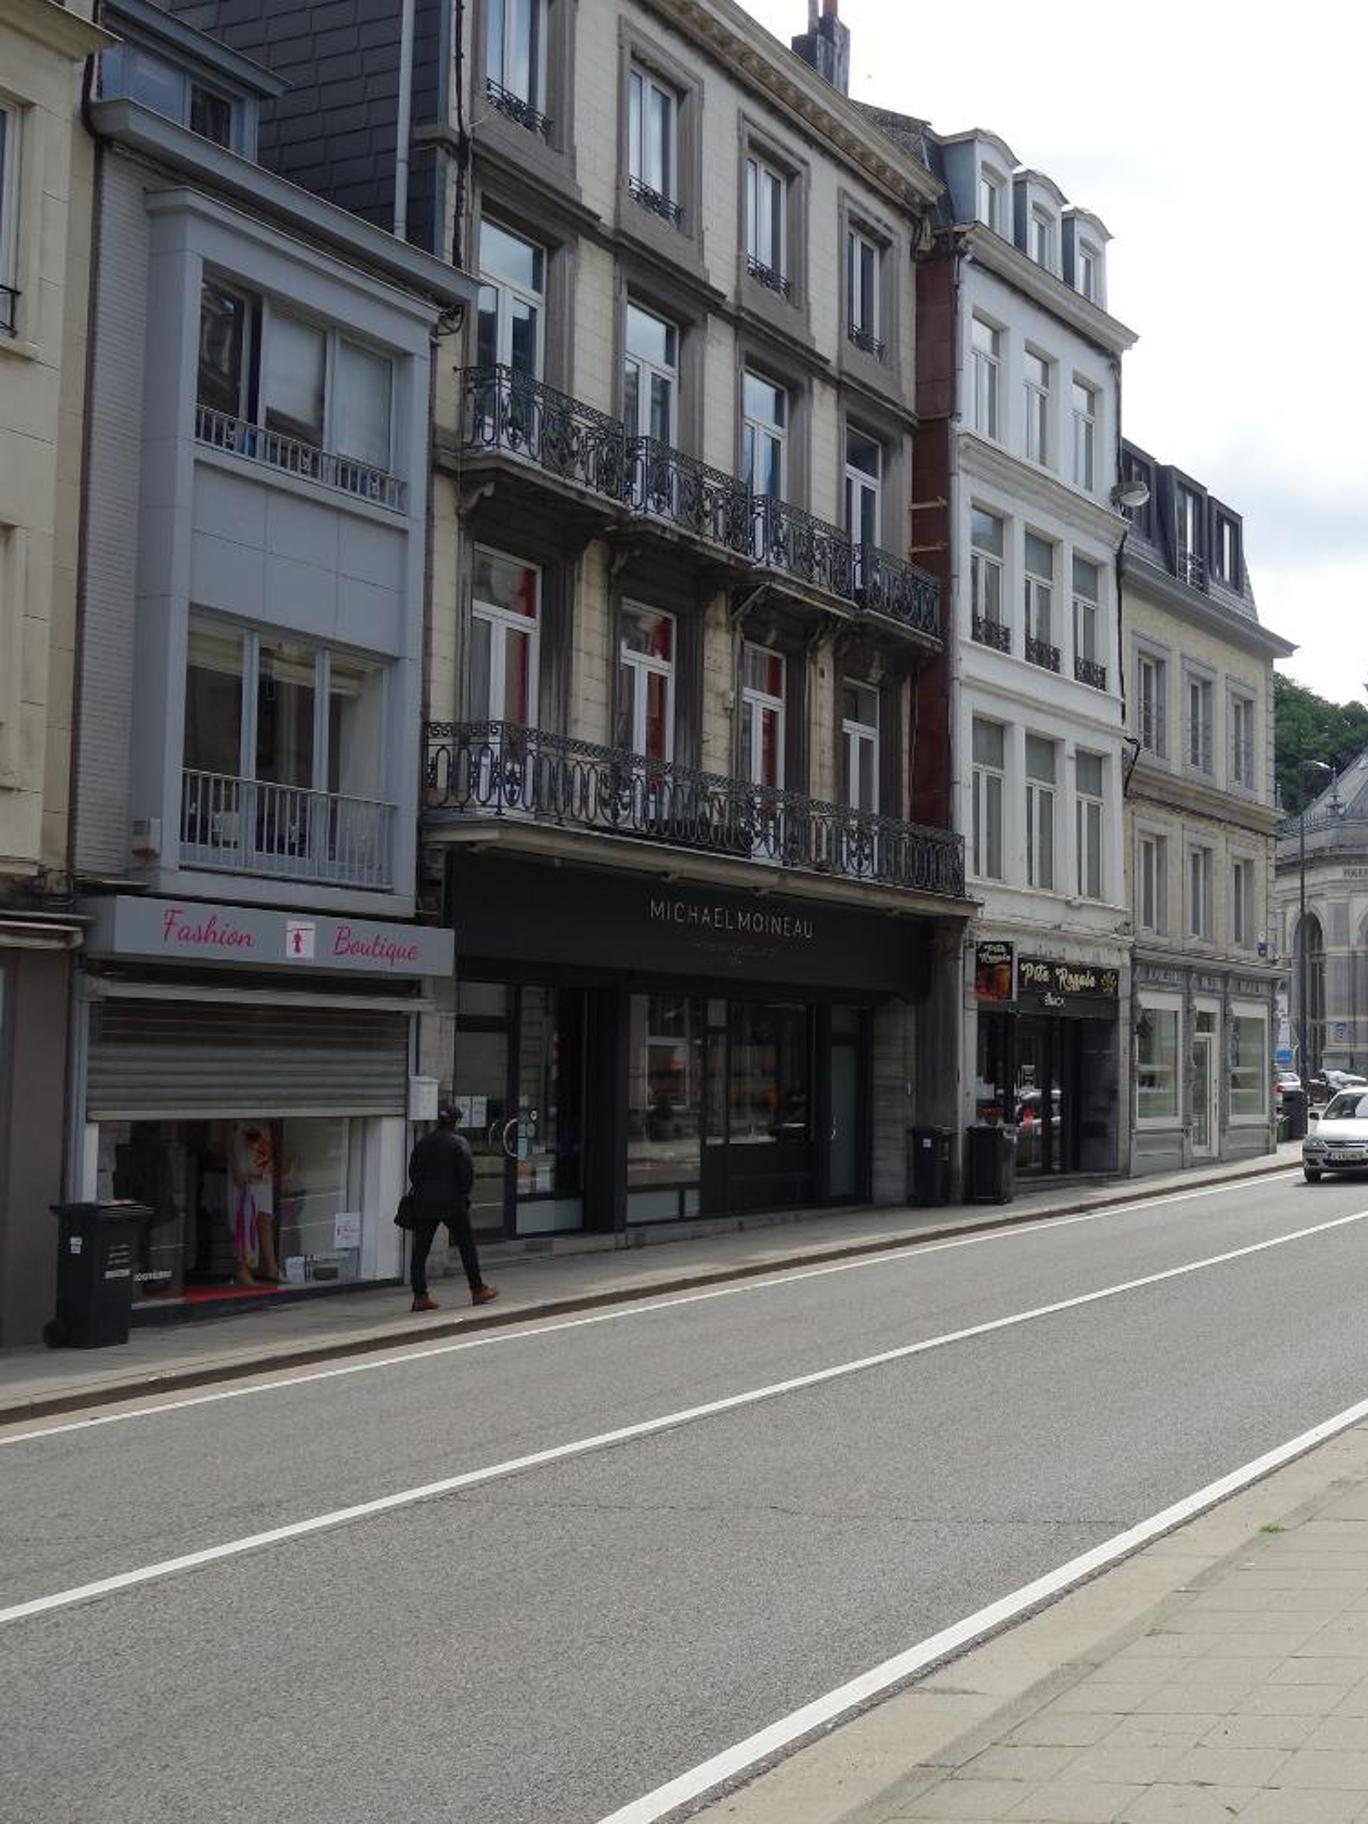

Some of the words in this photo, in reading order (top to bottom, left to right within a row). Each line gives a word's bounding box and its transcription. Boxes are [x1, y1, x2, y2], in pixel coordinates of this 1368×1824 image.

[163, 908, 256, 947] Fashion
[332, 924, 419, 964] Boutique
[650, 898, 734, 929] MICHAEL
[738, 911, 813, 938] MOINEAU
